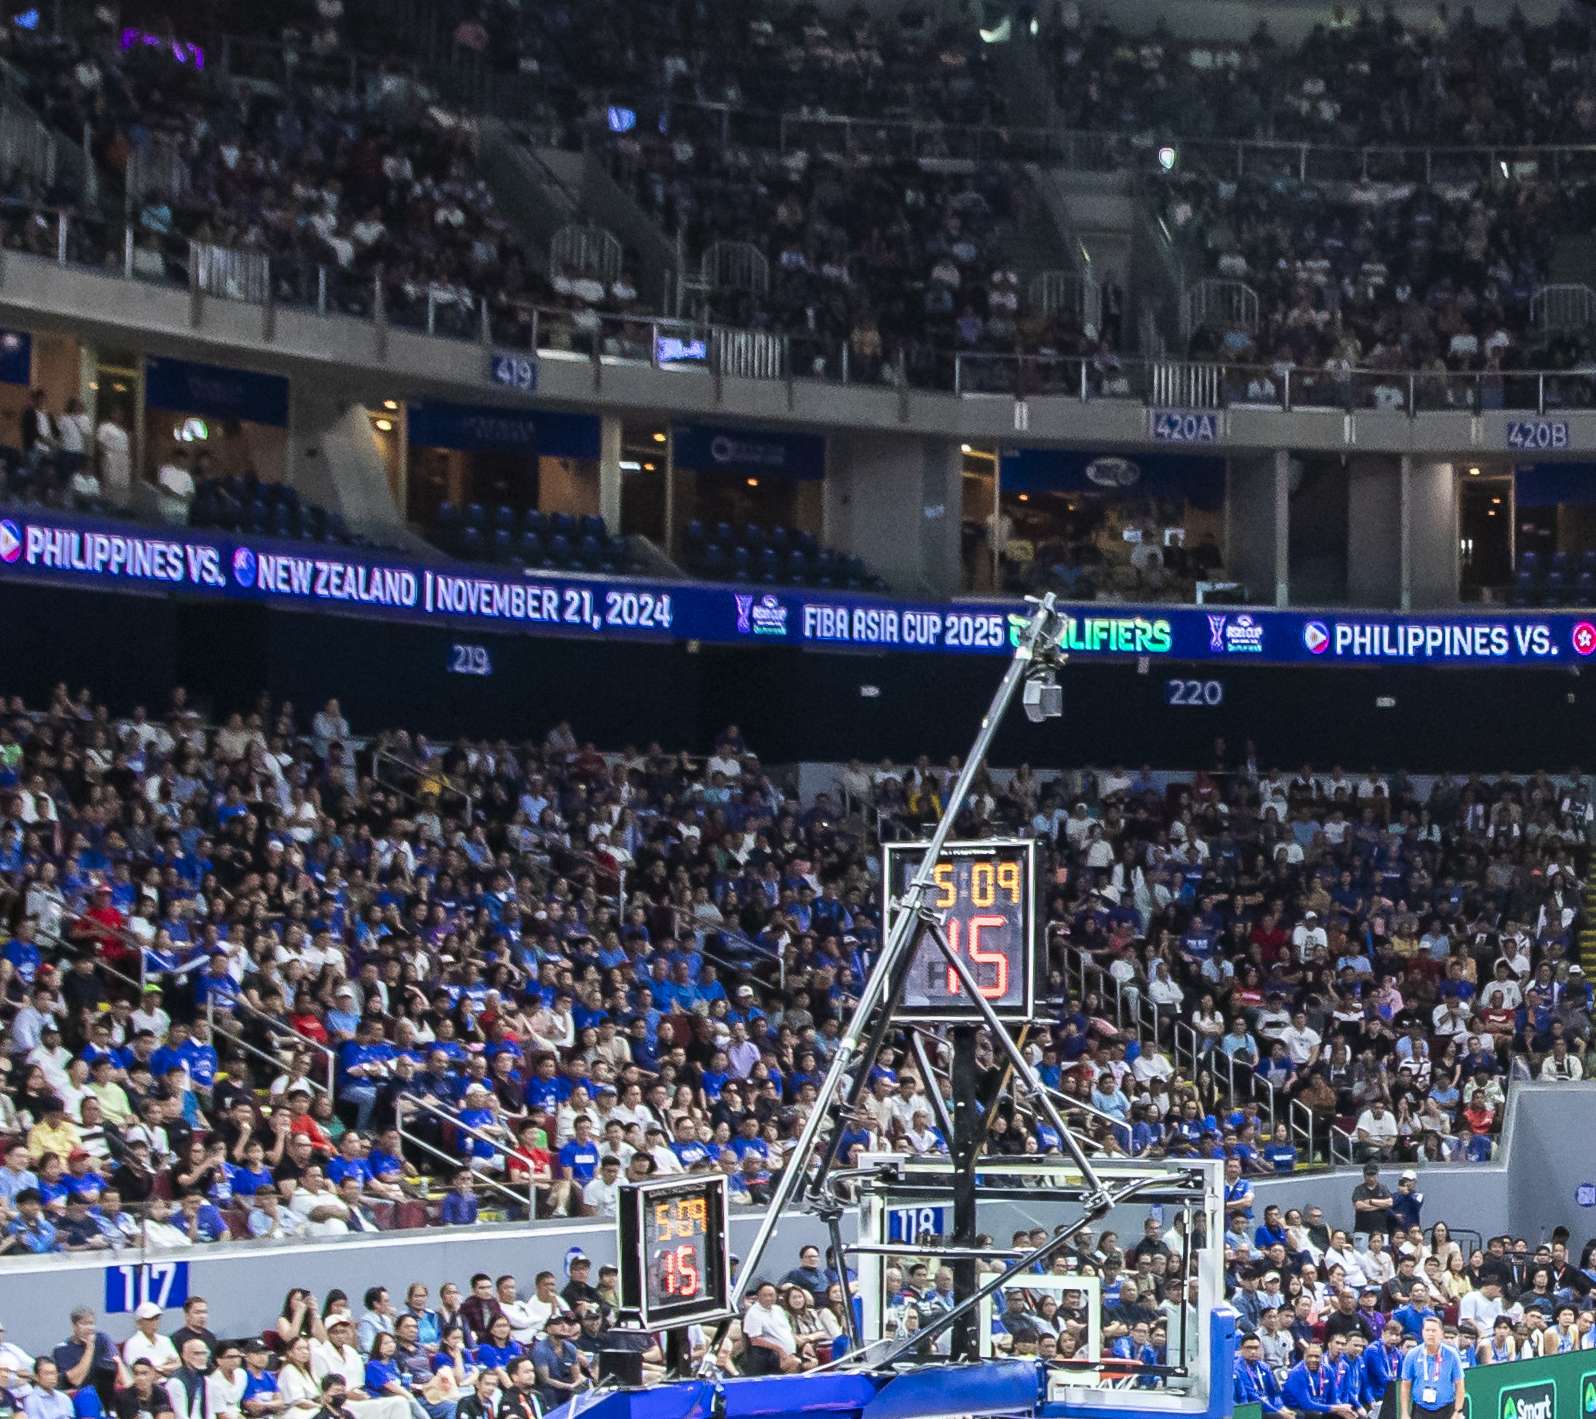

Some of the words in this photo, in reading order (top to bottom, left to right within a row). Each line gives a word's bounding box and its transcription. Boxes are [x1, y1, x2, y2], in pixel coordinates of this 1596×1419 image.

[1154, 411, 1215, 442] 420A
[1507, 421, 1569, 451] 420B
[25, 526, 183, 583] PHILIPPINES
[186, 542, 226, 587] VS.
[255, 552, 312, 597] NEW
[314, 558, 418, 608] ZEALAND
[436, 576, 560, 621] NOVEMBER
[564, 590, 602, 629] 21,
[605, 591, 673, 630] 2024
[803, 604, 850, 642] FIBA
[852, 607, 901, 644] ASIA
[902, 610, 942, 646] CUP
[944, 615, 1004, 648] 2025
[1009, 614, 1173, 656] QLIFIERS
[1334, 622, 1509, 658] PHILIPPINES
[1514, 624, 1560, 658] VS.
[451, 643, 490, 676] 219
[1167, 678, 1224, 706] 220
[932, 861, 1021, 908] 5:09
[947, 914, 1008, 999] 15
[897, 1207, 935, 1242] 118
[116, 1260, 177, 1313] 117
[665, 1246, 699, 1296] 15
